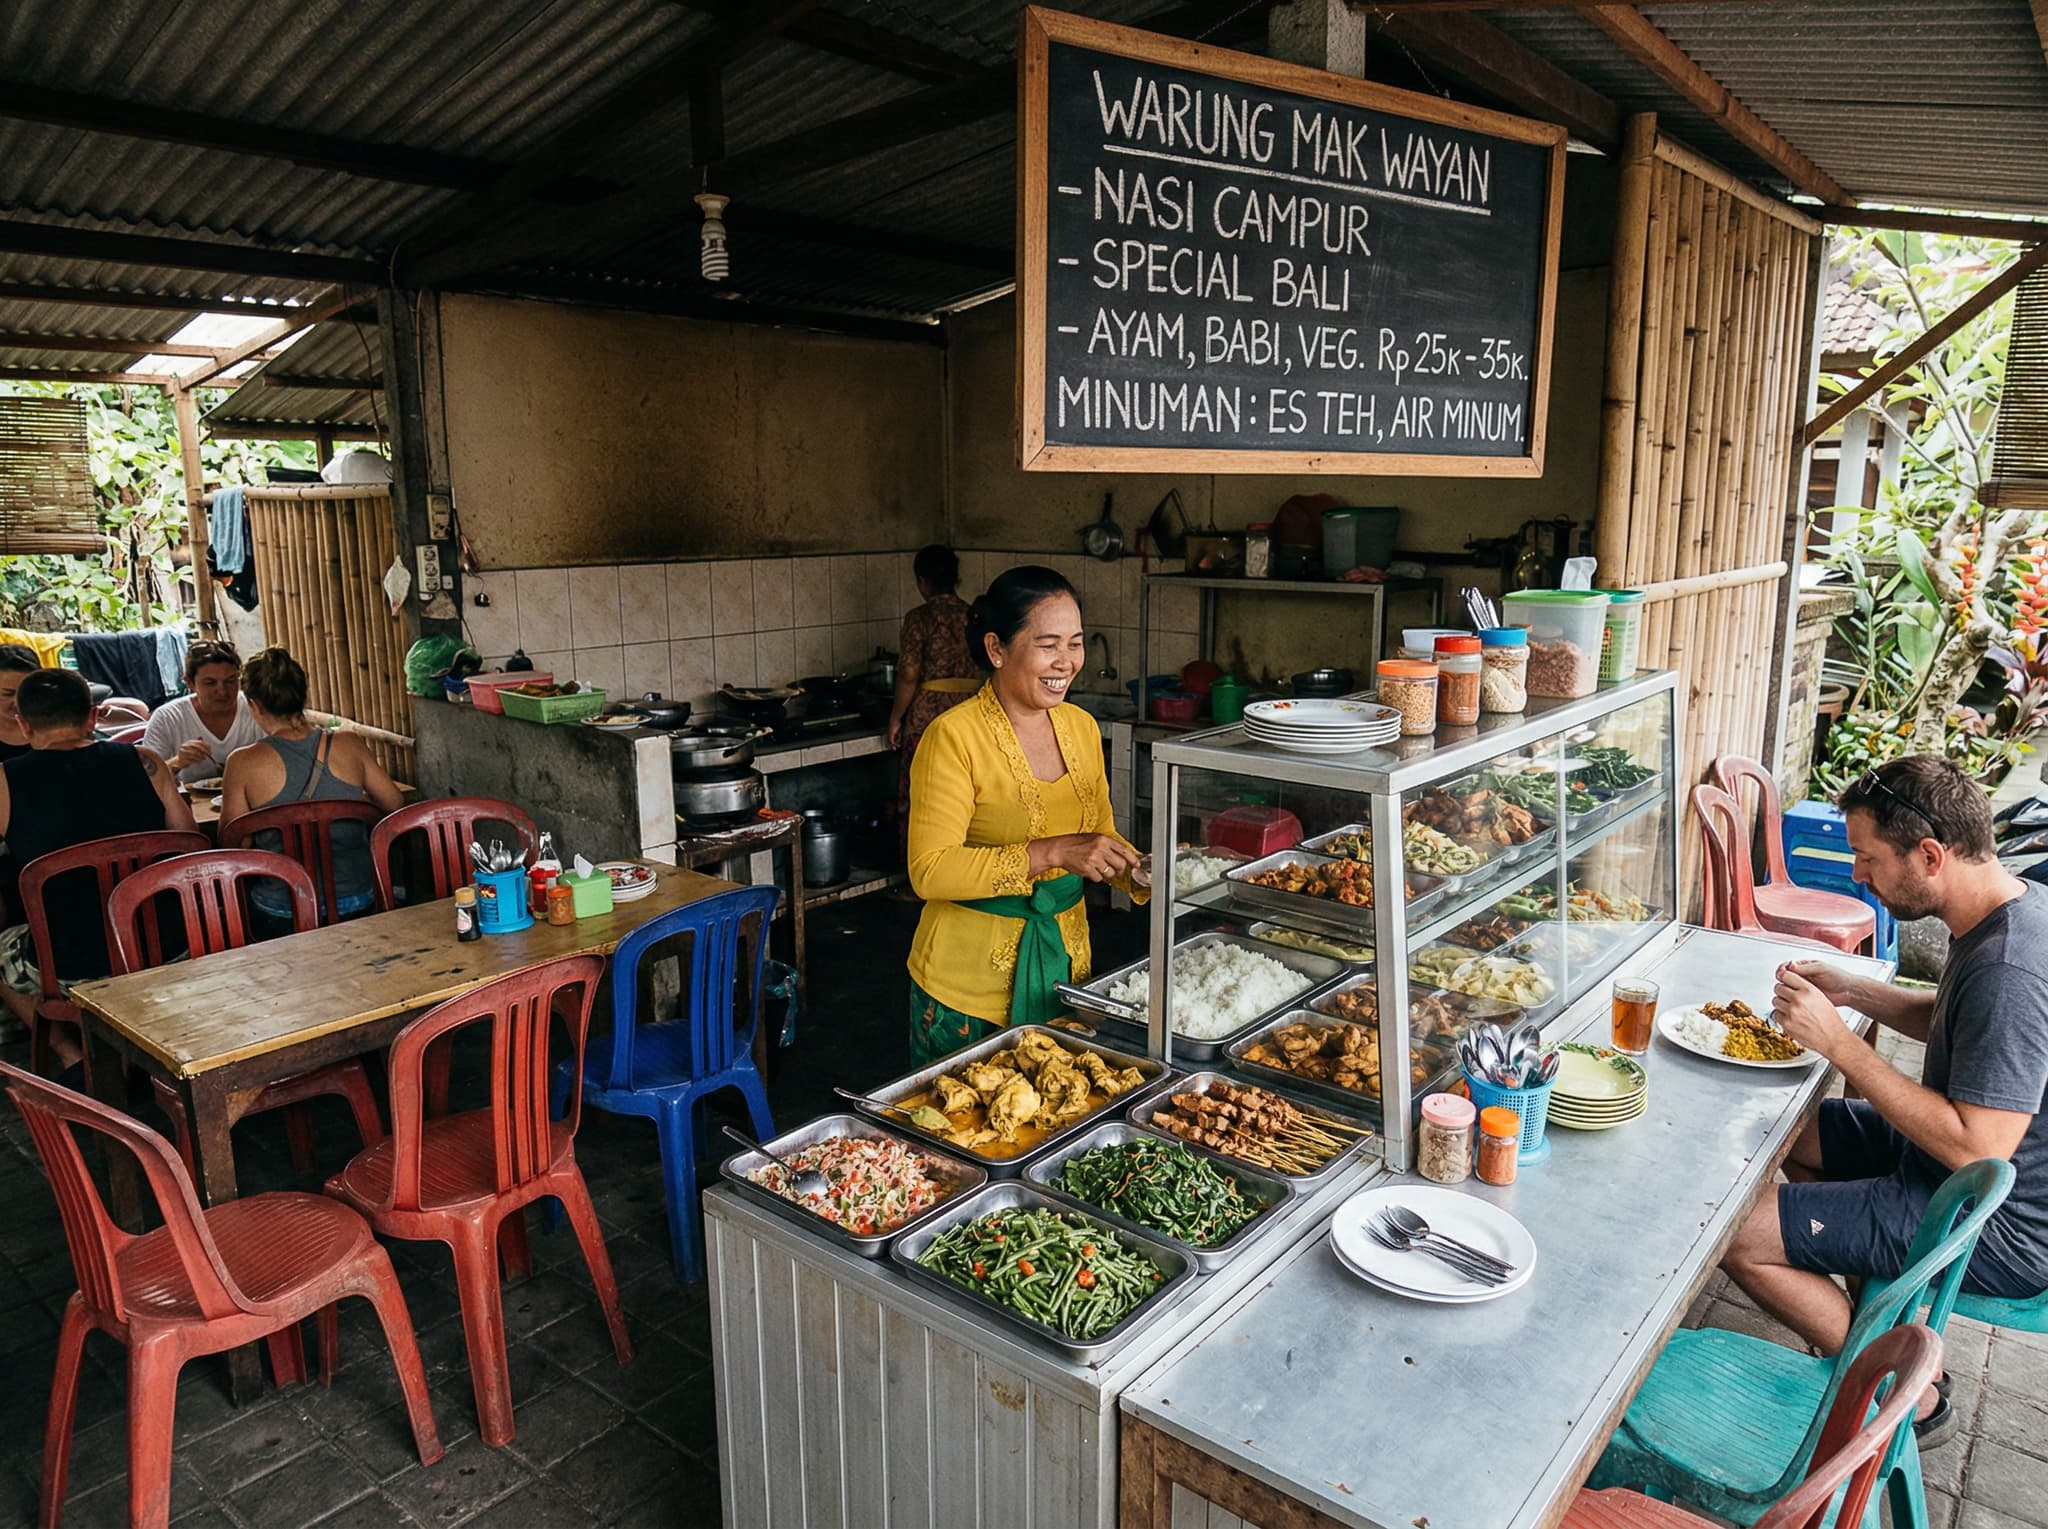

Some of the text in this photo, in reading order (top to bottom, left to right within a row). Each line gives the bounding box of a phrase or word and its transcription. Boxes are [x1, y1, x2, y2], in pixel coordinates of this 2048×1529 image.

[1093, 70, 1490, 204] WARUNG MAK WAYAN
[1094, 166, 1194, 233] NASI
[1213, 185, 1372, 257] CAMPUR
[1092, 238, 1254, 303] SPECIAL
[1272, 258, 1350, 312] BALI
[1088, 307, 1196, 370] AYAM,
[1205, 315, 1292, 376] BABI,
[1298, 325, 1365, 371] VEG.
[1268, 389, 1308, 434] ES
[1316, 391, 1384, 445] TEH,
[1389, 396, 1435, 440] AIR
[1441, 398, 1526, 443] MINUM.
